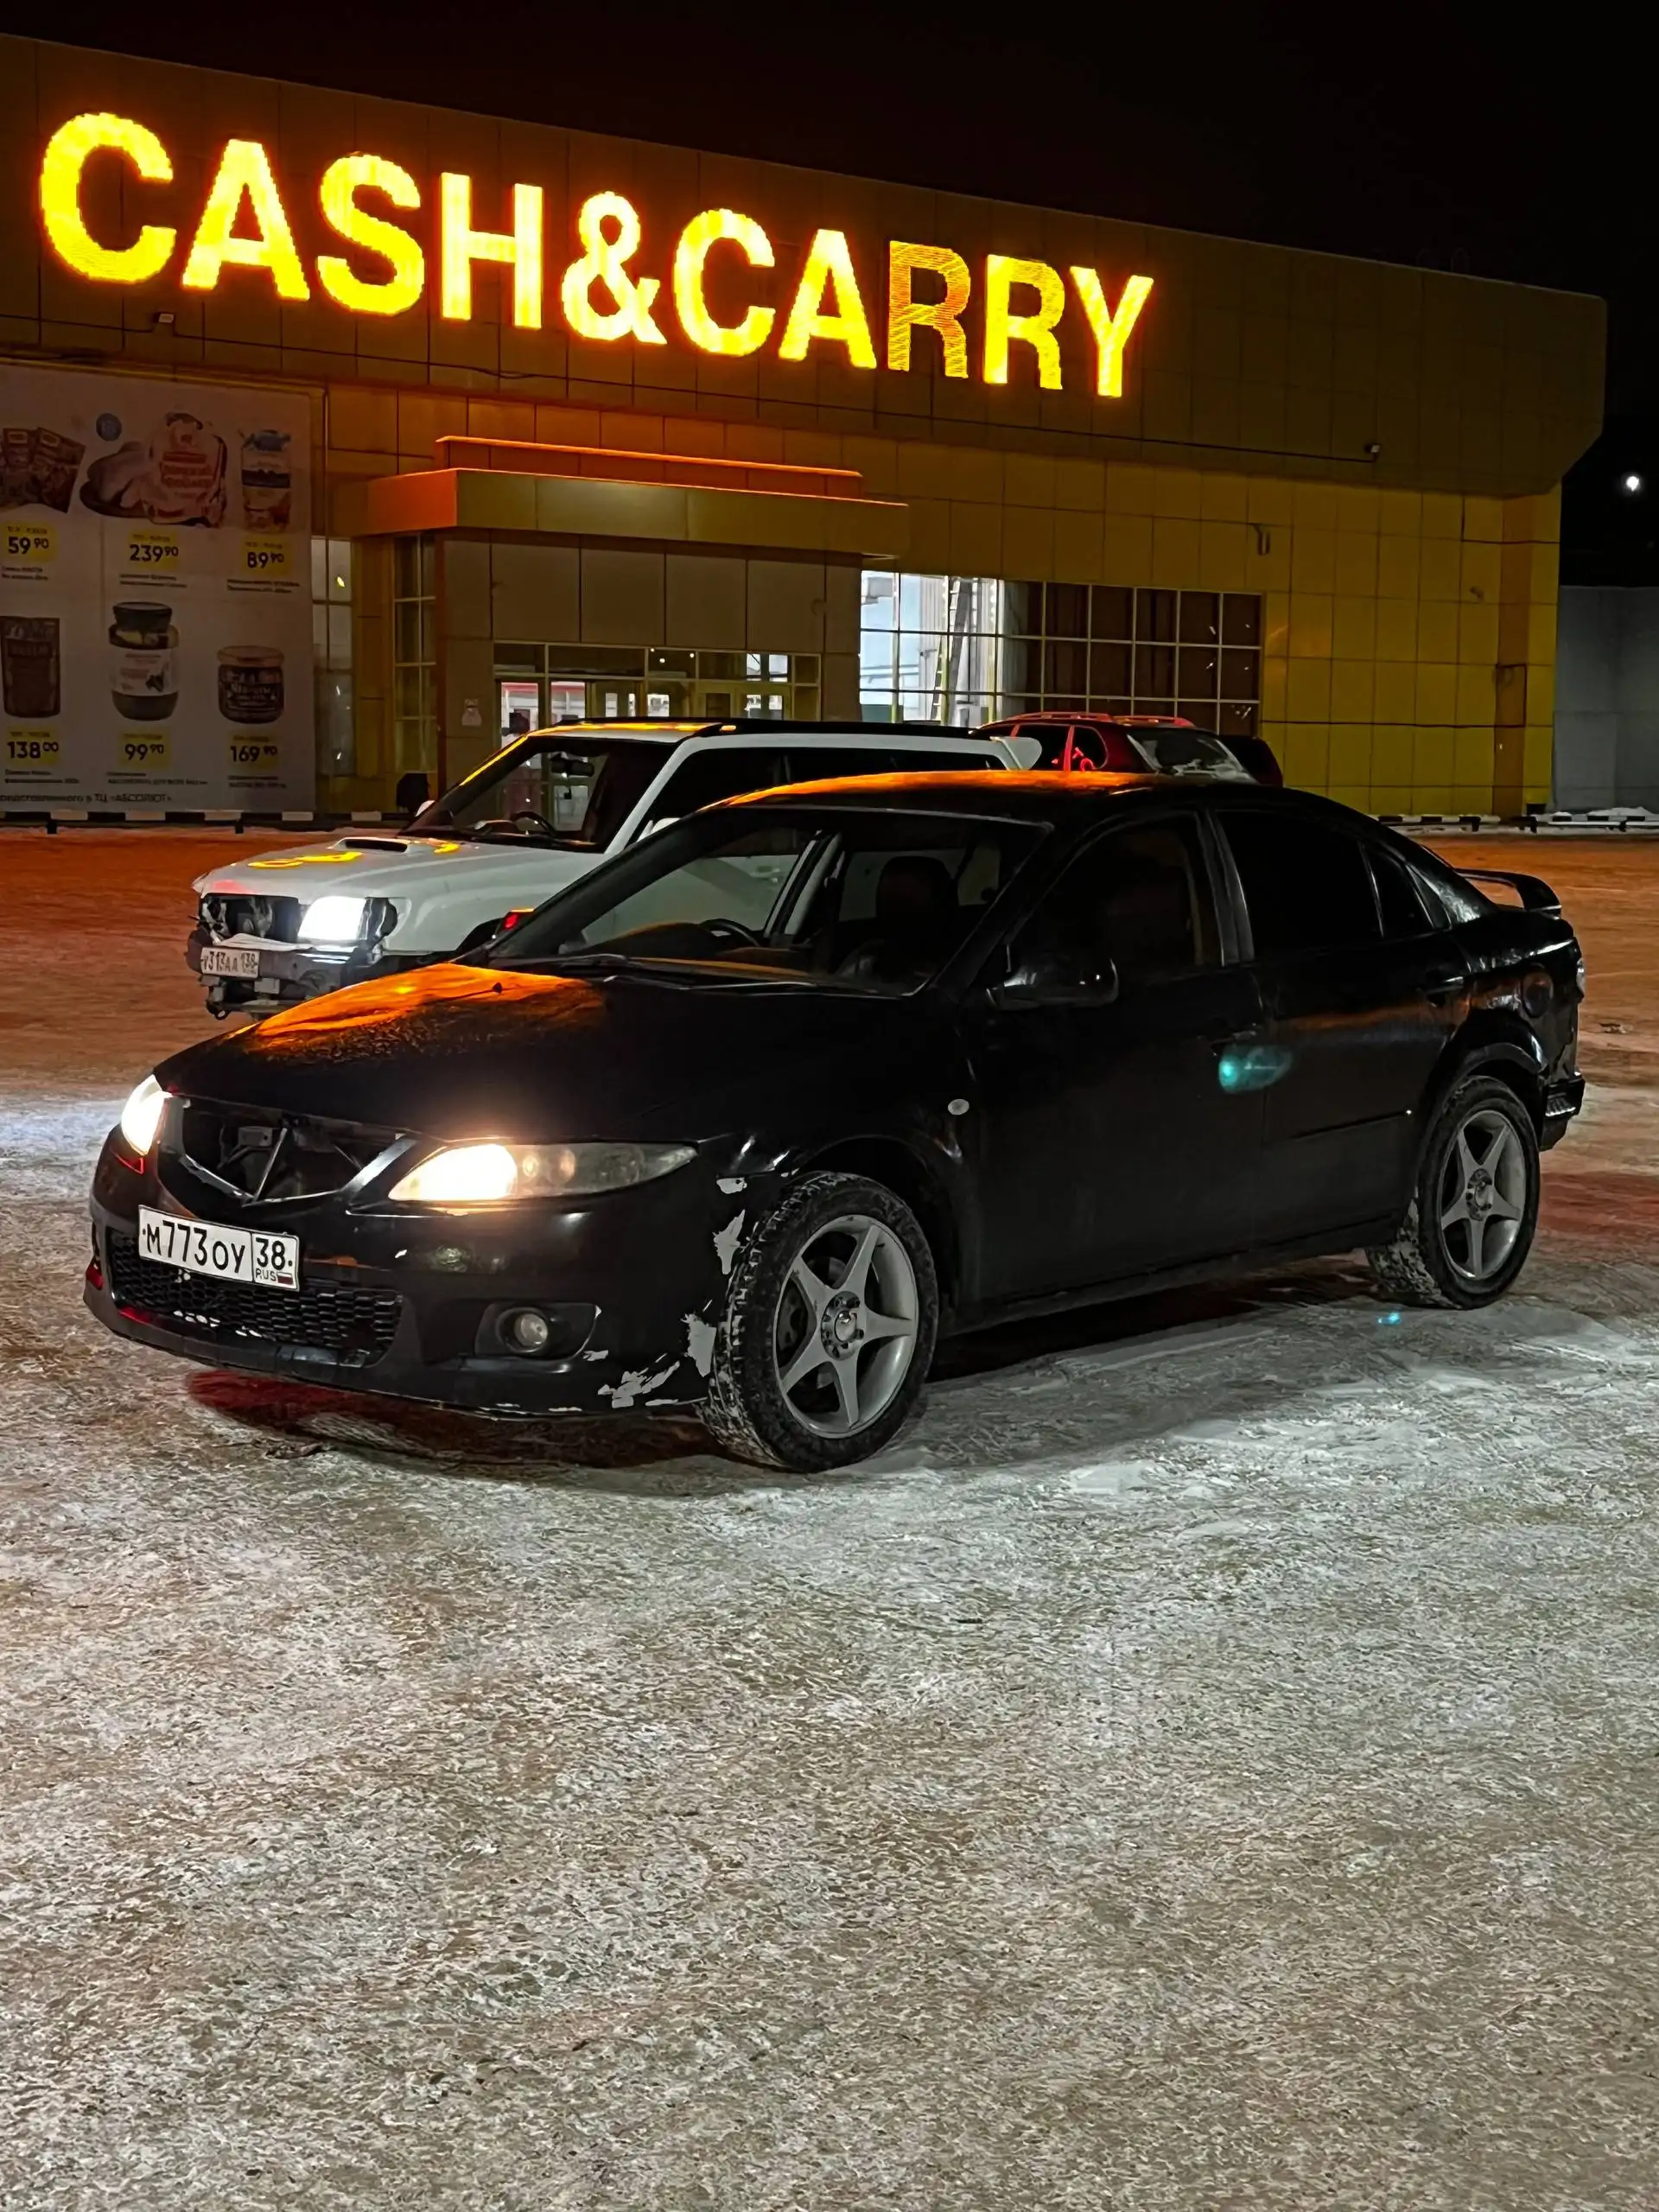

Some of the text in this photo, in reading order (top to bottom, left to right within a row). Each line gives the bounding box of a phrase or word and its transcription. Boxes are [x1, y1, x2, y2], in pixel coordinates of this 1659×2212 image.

[40, 111, 1154, 398] CASH&CARRY
[146, 1220, 286, 1274] М773ОУ 38
[256, 1268, 277, 1281] RUS
